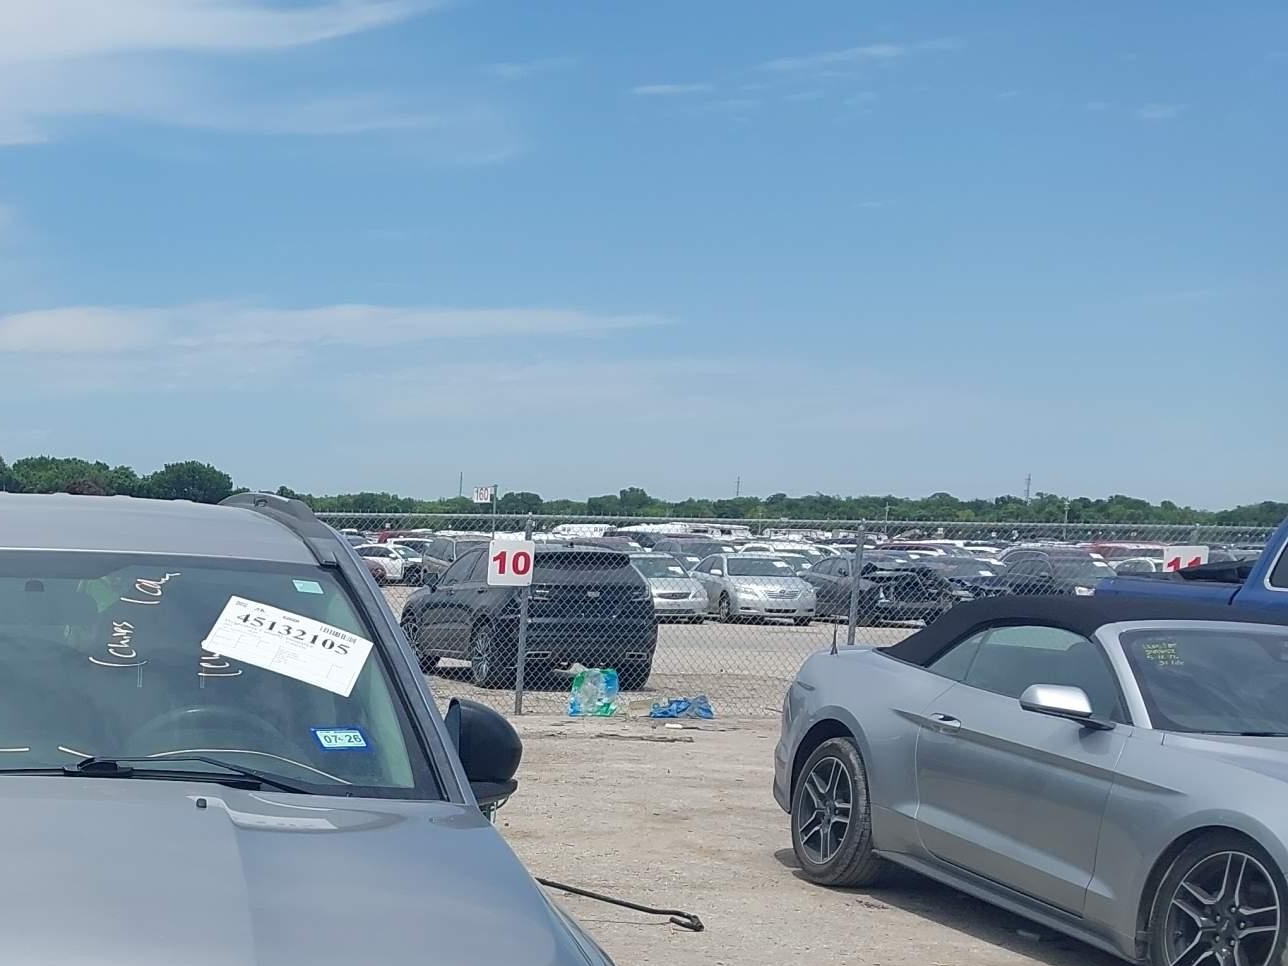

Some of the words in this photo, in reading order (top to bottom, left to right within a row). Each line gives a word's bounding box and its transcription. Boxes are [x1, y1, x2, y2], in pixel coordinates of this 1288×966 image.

[475, 488, 489, 500] 160
[493, 551, 531, 575] 10
[236, 613, 351, 656] 45132105
[324, 735, 338, 743] 07
